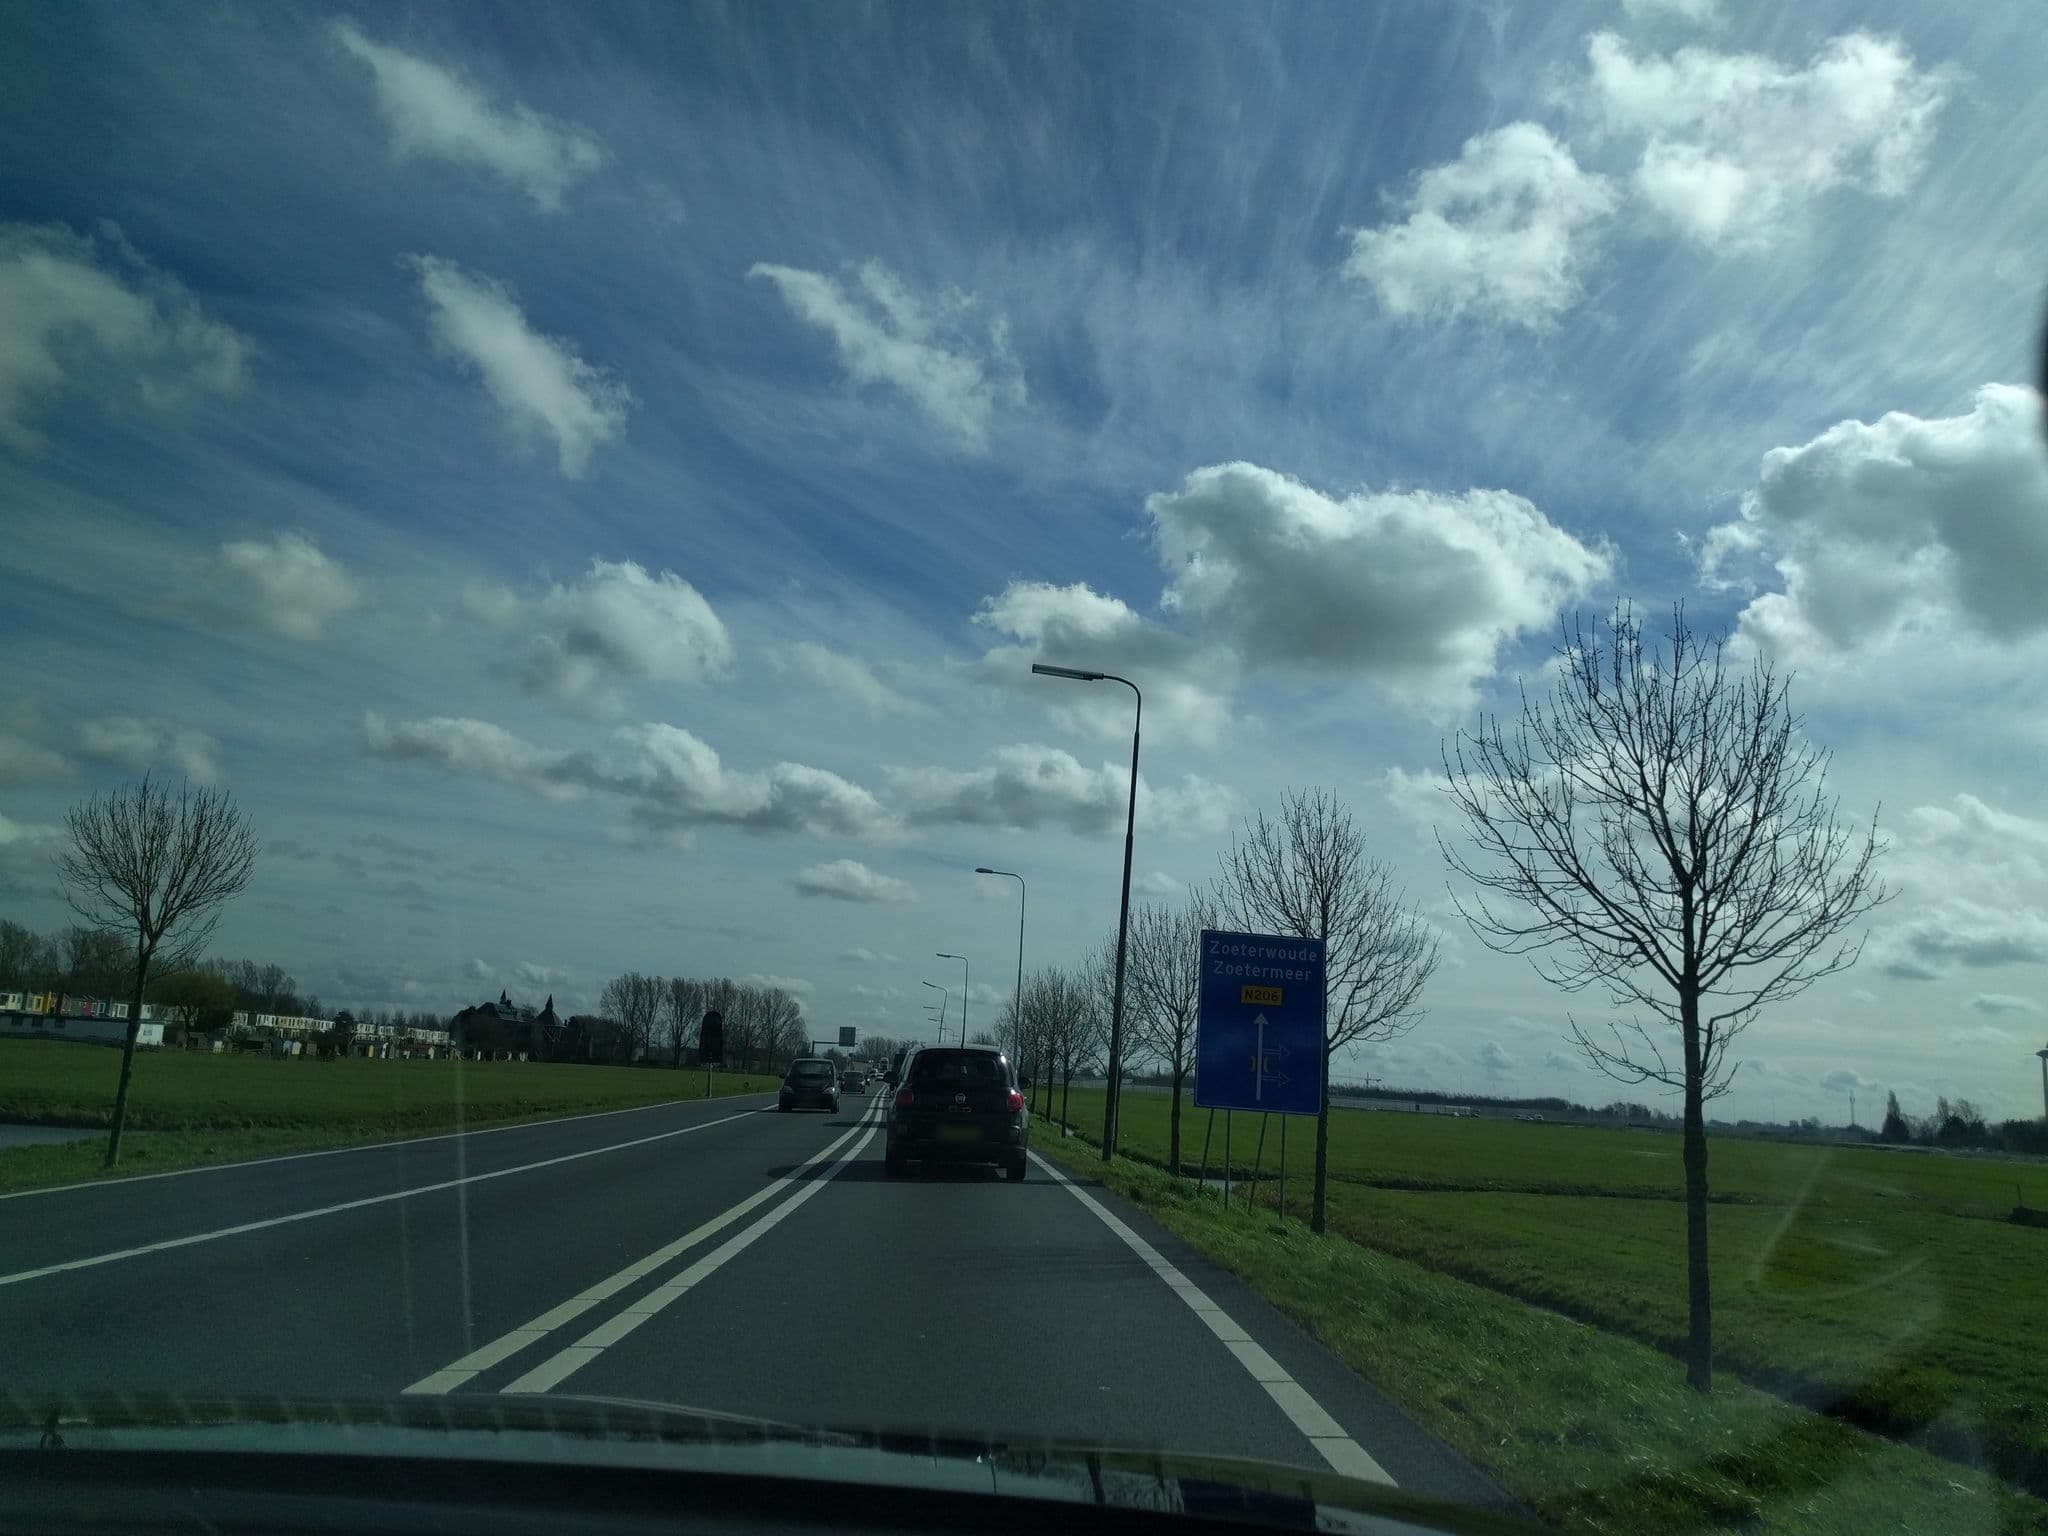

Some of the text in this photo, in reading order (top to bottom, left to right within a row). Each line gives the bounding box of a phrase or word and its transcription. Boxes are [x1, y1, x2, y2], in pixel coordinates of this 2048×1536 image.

[1208, 940, 1318, 962] Zoeterwoude
[1213, 960, 1312, 981] Zoetermeer
[1244, 989, 1279, 1002] N206
